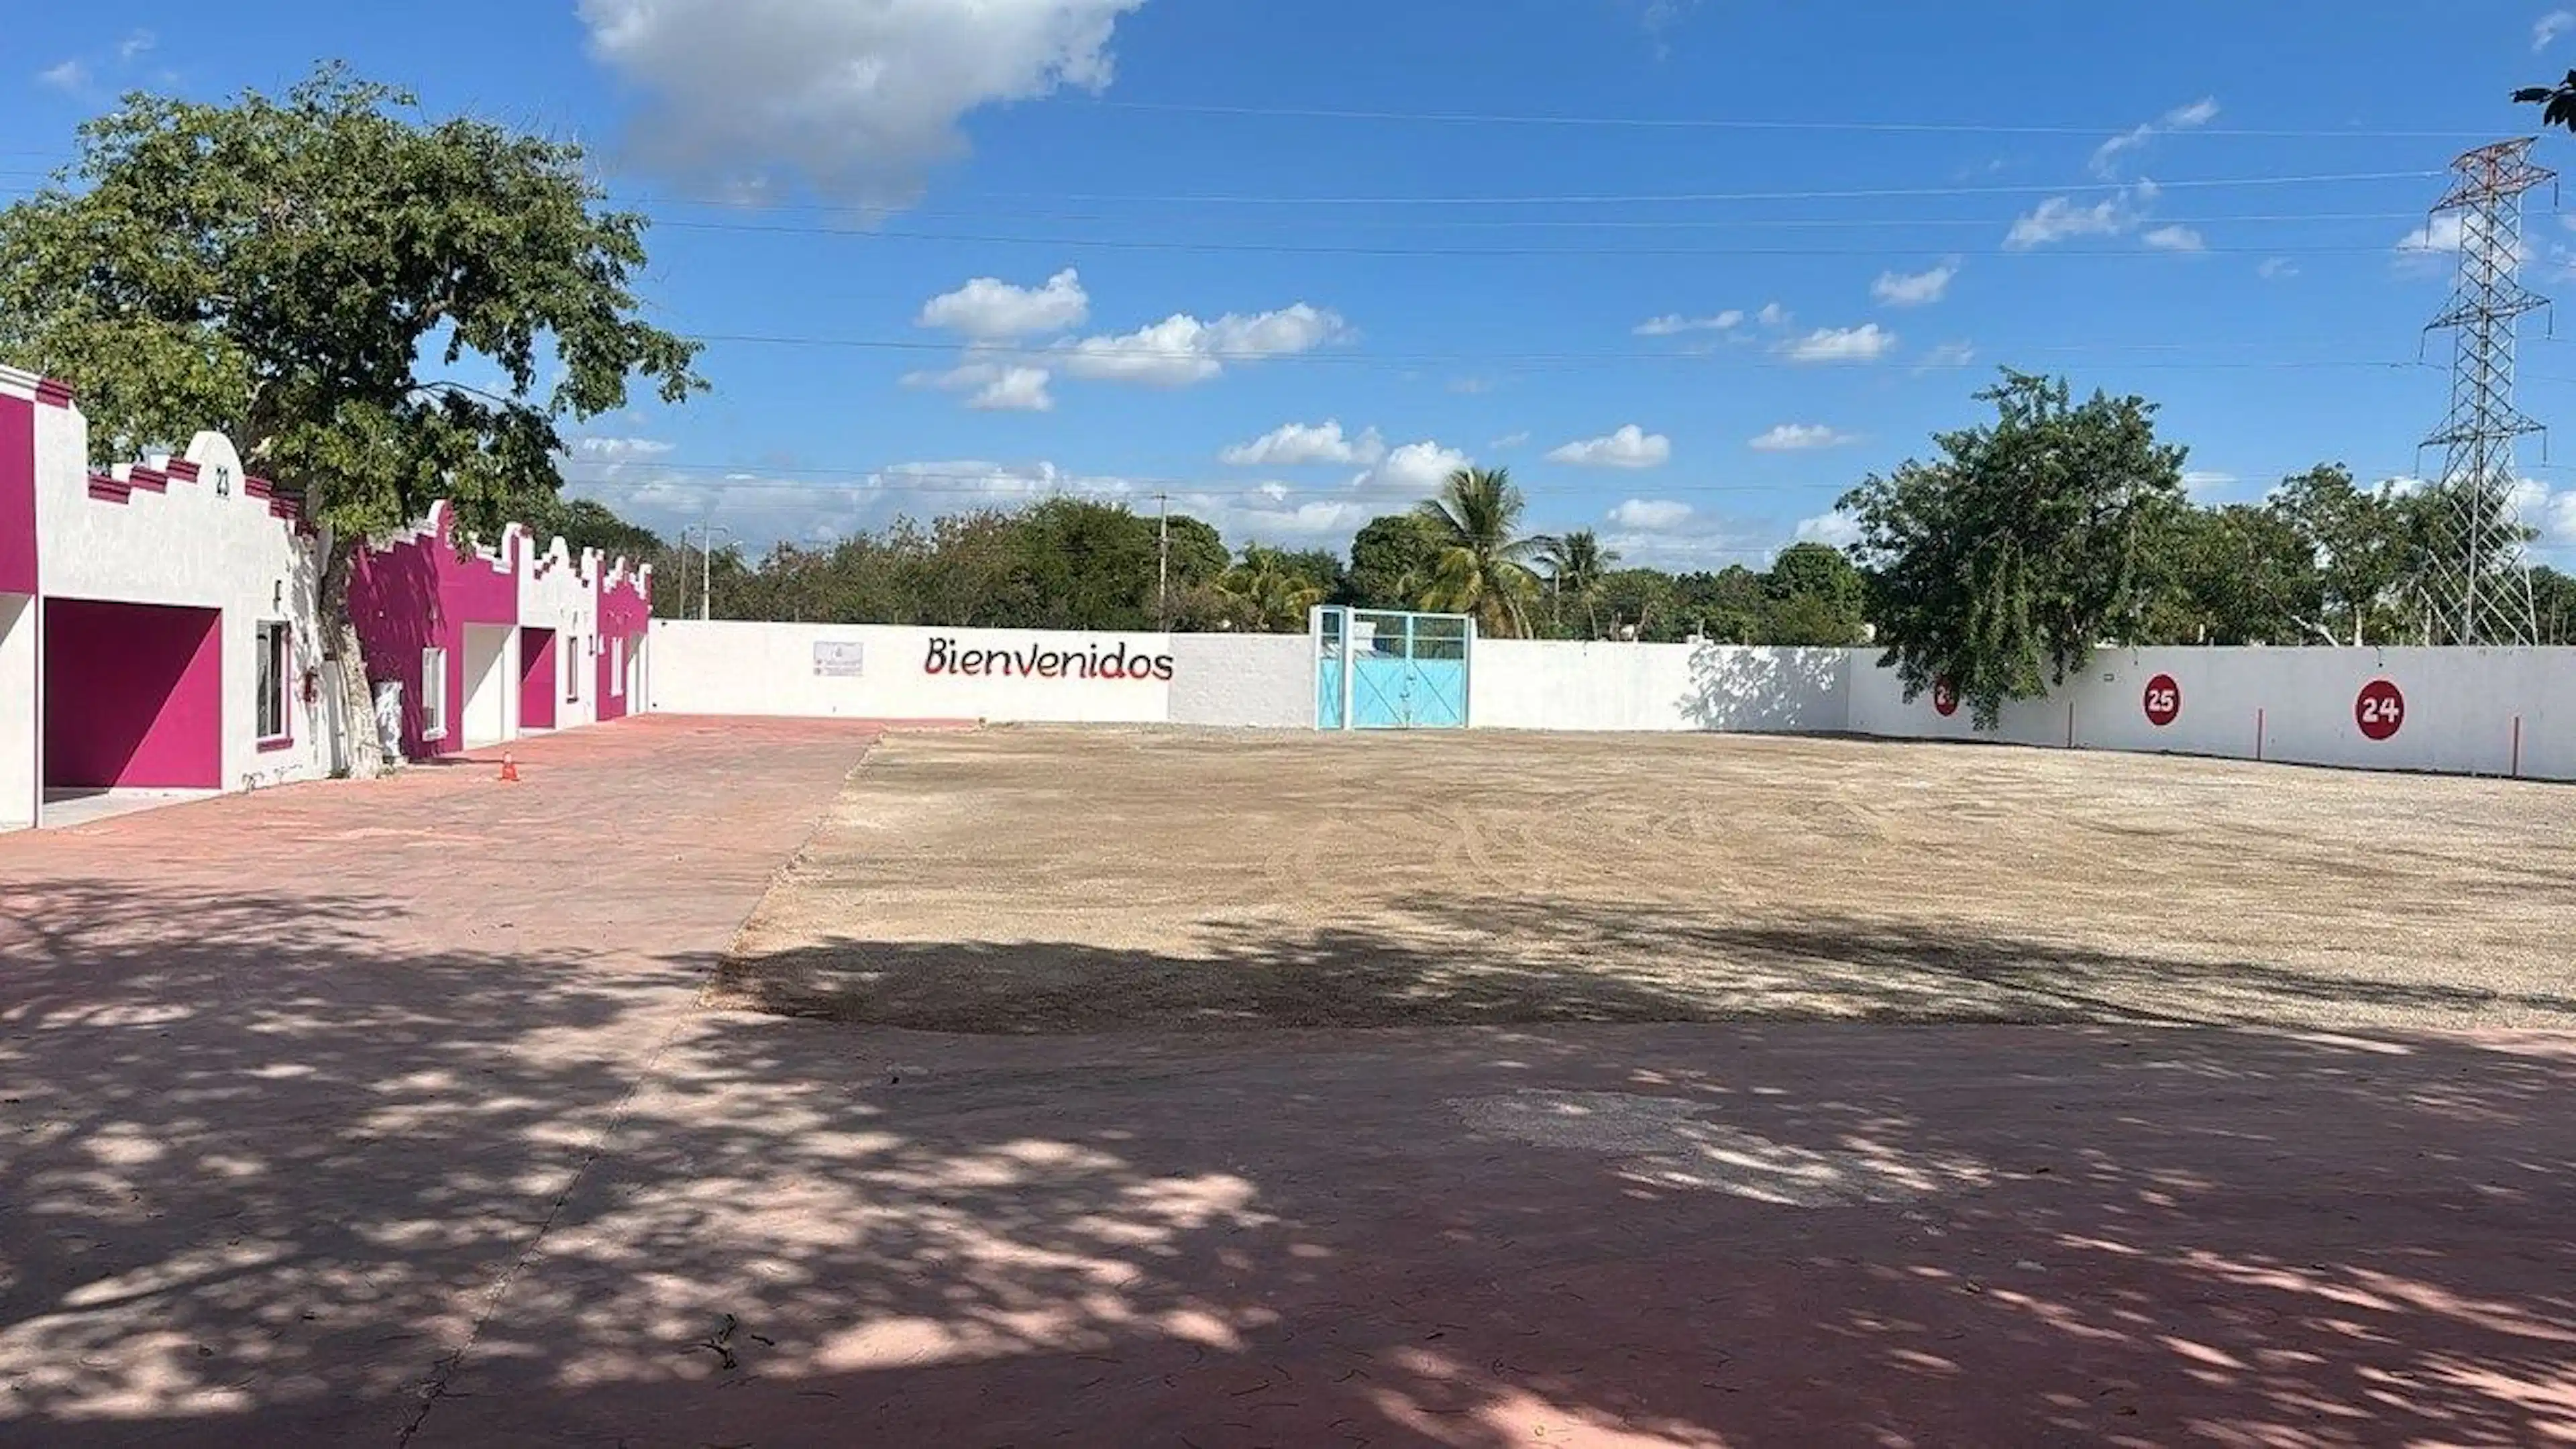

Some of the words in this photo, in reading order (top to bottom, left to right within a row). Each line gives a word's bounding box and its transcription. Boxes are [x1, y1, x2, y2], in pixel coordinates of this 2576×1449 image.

[216, 466, 229, 496] 23
[924, 637, 1174, 681] Bienvenidos
[2148, 689, 2174, 712] 25
[2362, 696, 2400, 723] 24
